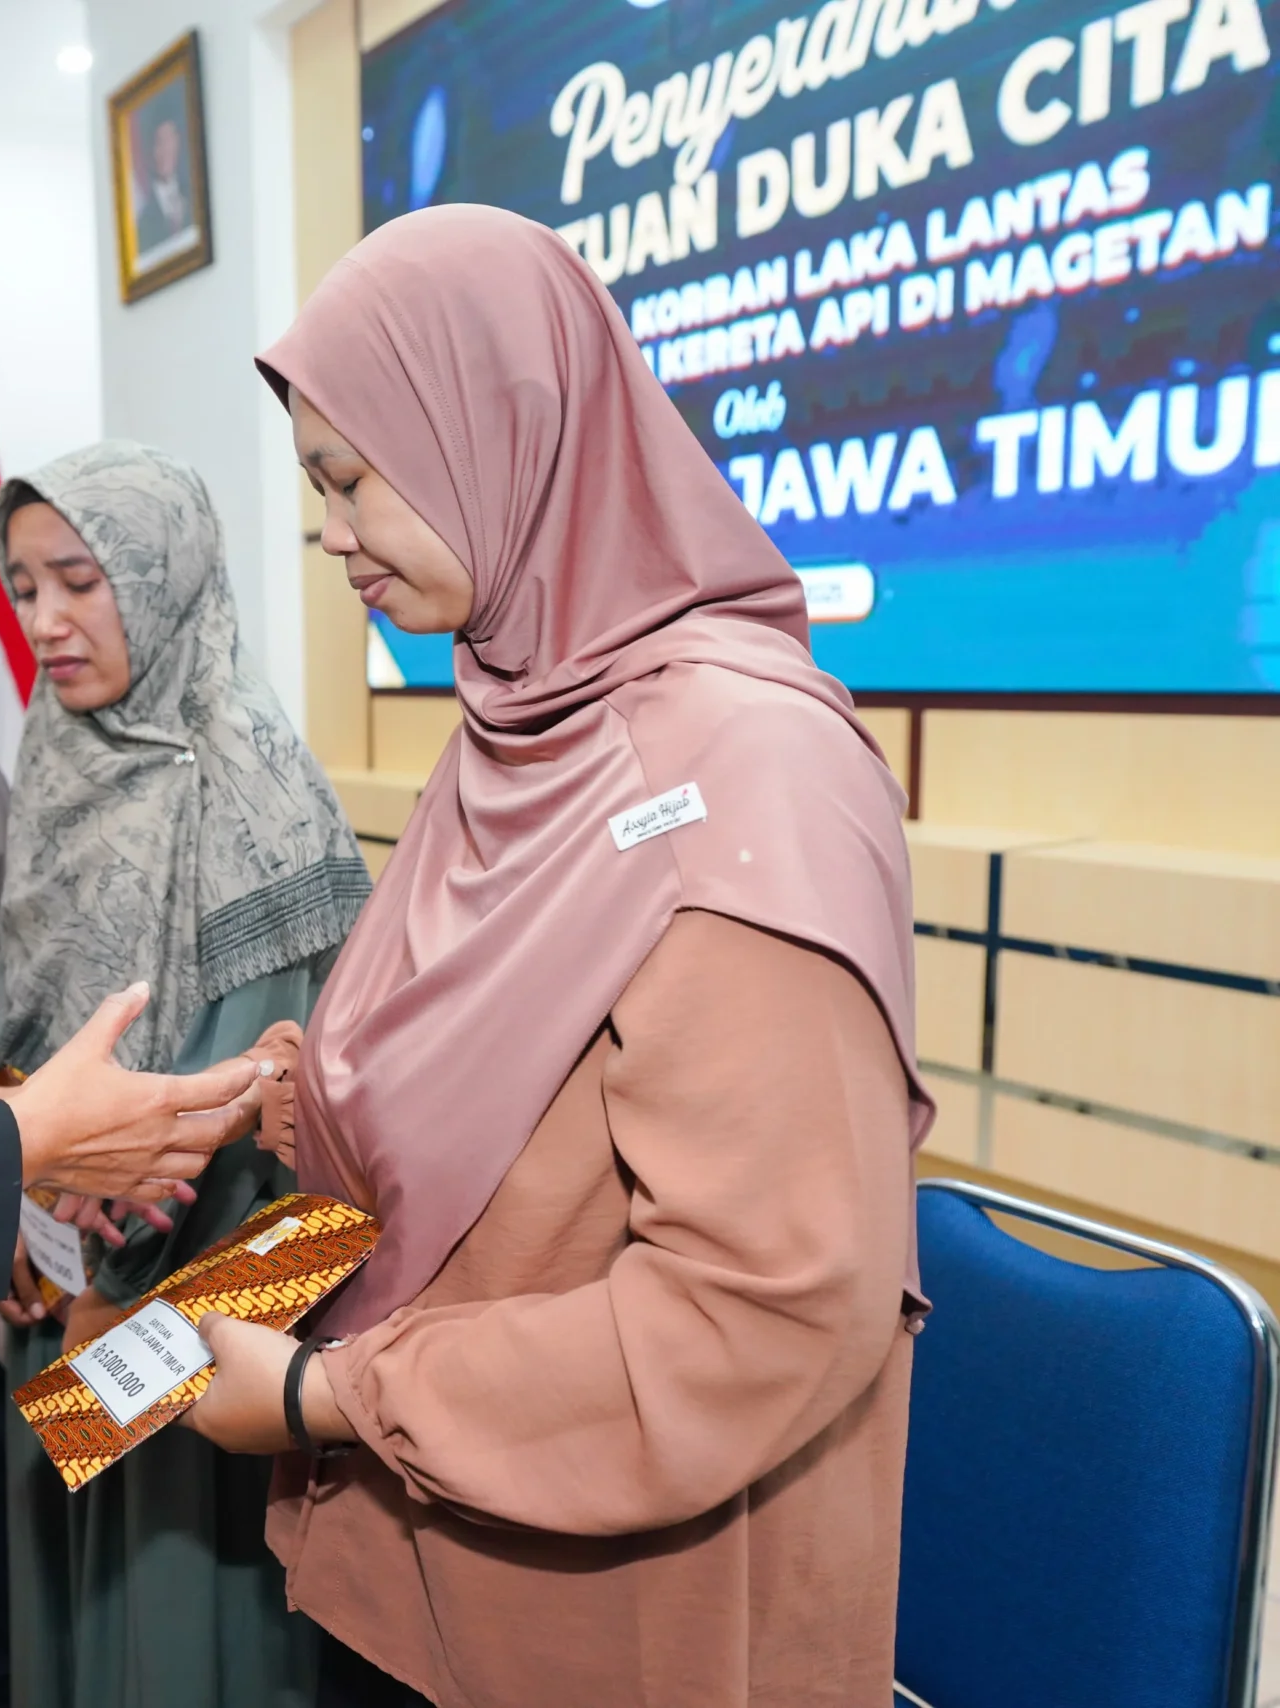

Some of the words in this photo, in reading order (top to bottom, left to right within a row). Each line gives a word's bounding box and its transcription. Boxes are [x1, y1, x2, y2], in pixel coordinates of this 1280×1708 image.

[549, 0, 1019, 205] Penyera
[736, 78, 974, 239] DUKA
[997, 0, 1270, 146] CITA
[631, 256, 788, 342] KORBAN
[794, 219, 918, 298] LAKA
[925, 145, 1151, 262] LANTAS
[658, 307, 806, 384] KERETA
[809, 283, 891, 350] API
[898, 267, 955, 331] DI
[964, 182, 1272, 317] MAGETAN
[729, 425, 957, 525] JAWA
[658, 795, 691, 818] Hijab
[142, 1331, 166, 1356] JAWA
[160, 1350, 186, 1377] TIMUR
[148, 1318, 174, 1341] BANTUAN
